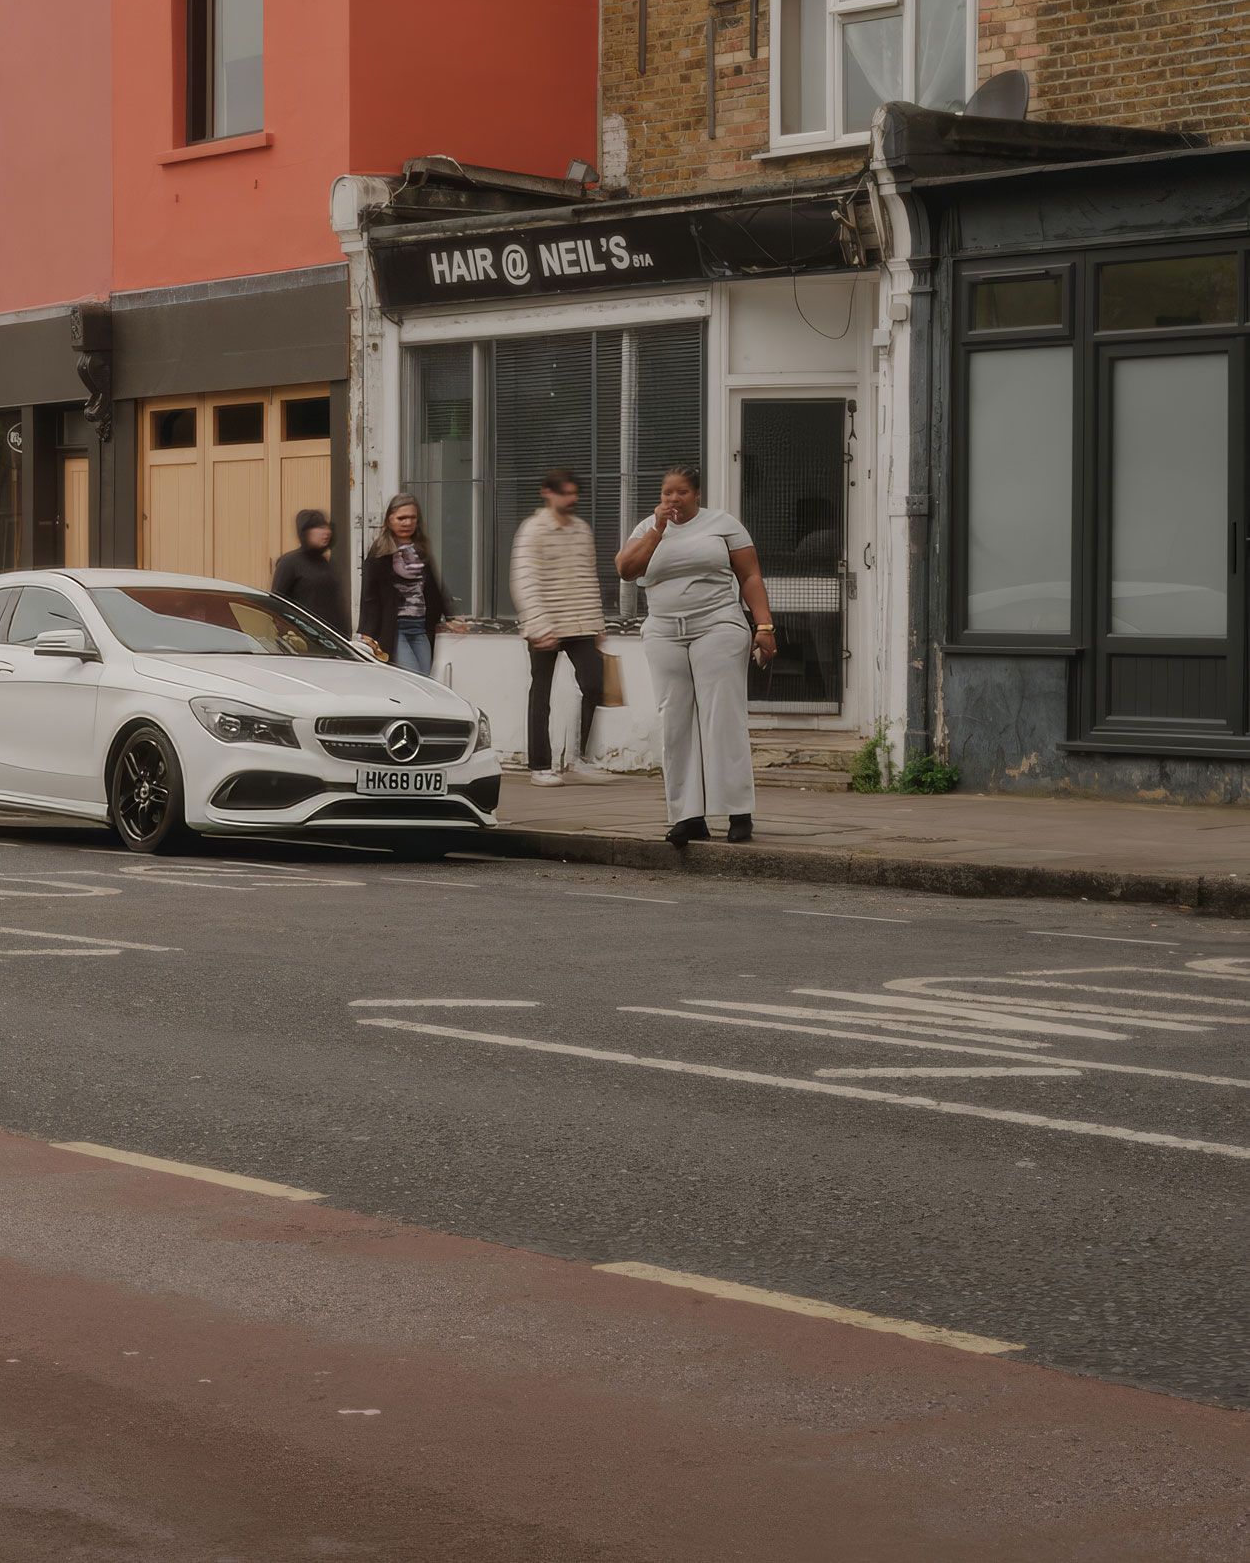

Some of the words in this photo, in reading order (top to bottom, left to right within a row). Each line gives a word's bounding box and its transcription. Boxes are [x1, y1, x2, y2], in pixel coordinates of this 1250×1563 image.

[430, 248, 498, 285] HAIR
[502, 244, 531, 286] @
[538, 235, 630, 277] NEIL'S
